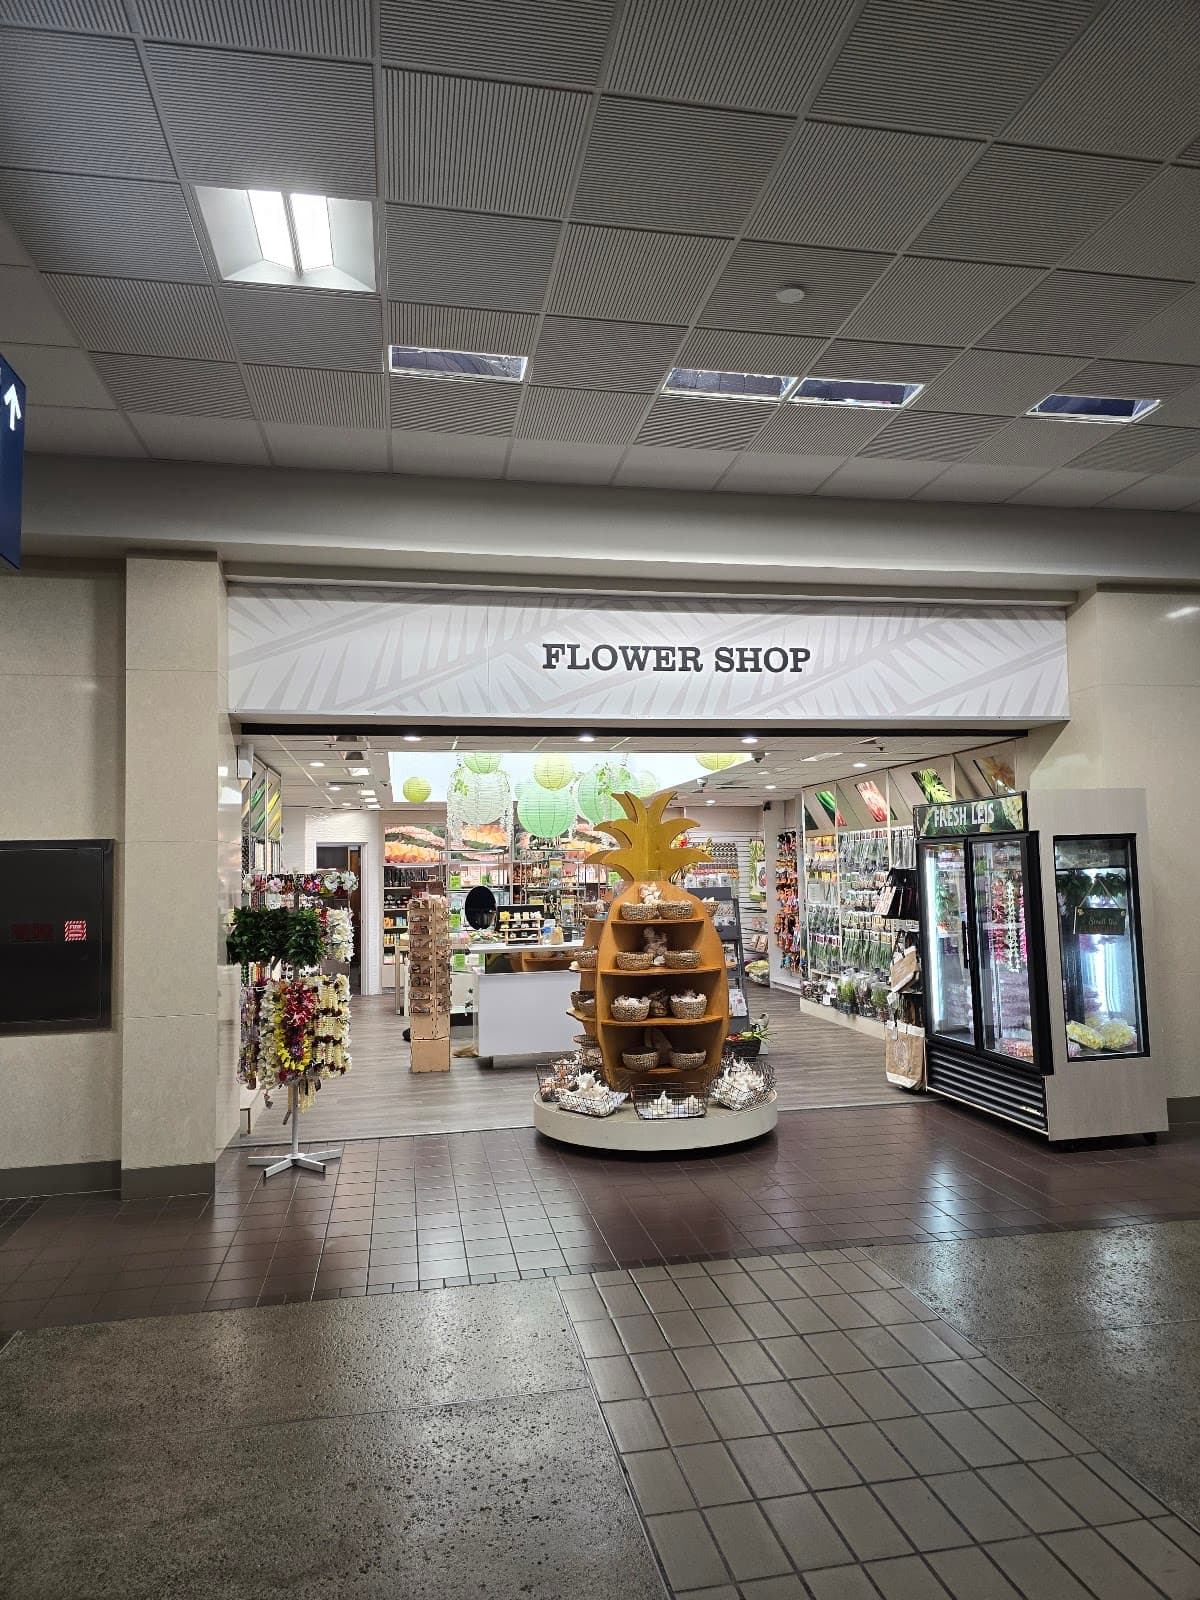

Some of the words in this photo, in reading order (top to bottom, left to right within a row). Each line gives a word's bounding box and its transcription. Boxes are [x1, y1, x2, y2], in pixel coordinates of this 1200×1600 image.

[542, 644, 703, 672] FLOWER
[714, 647, 811, 673] SHOP
[934, 806, 967, 827] FRESH
[971, 803, 995, 824] LEIS
